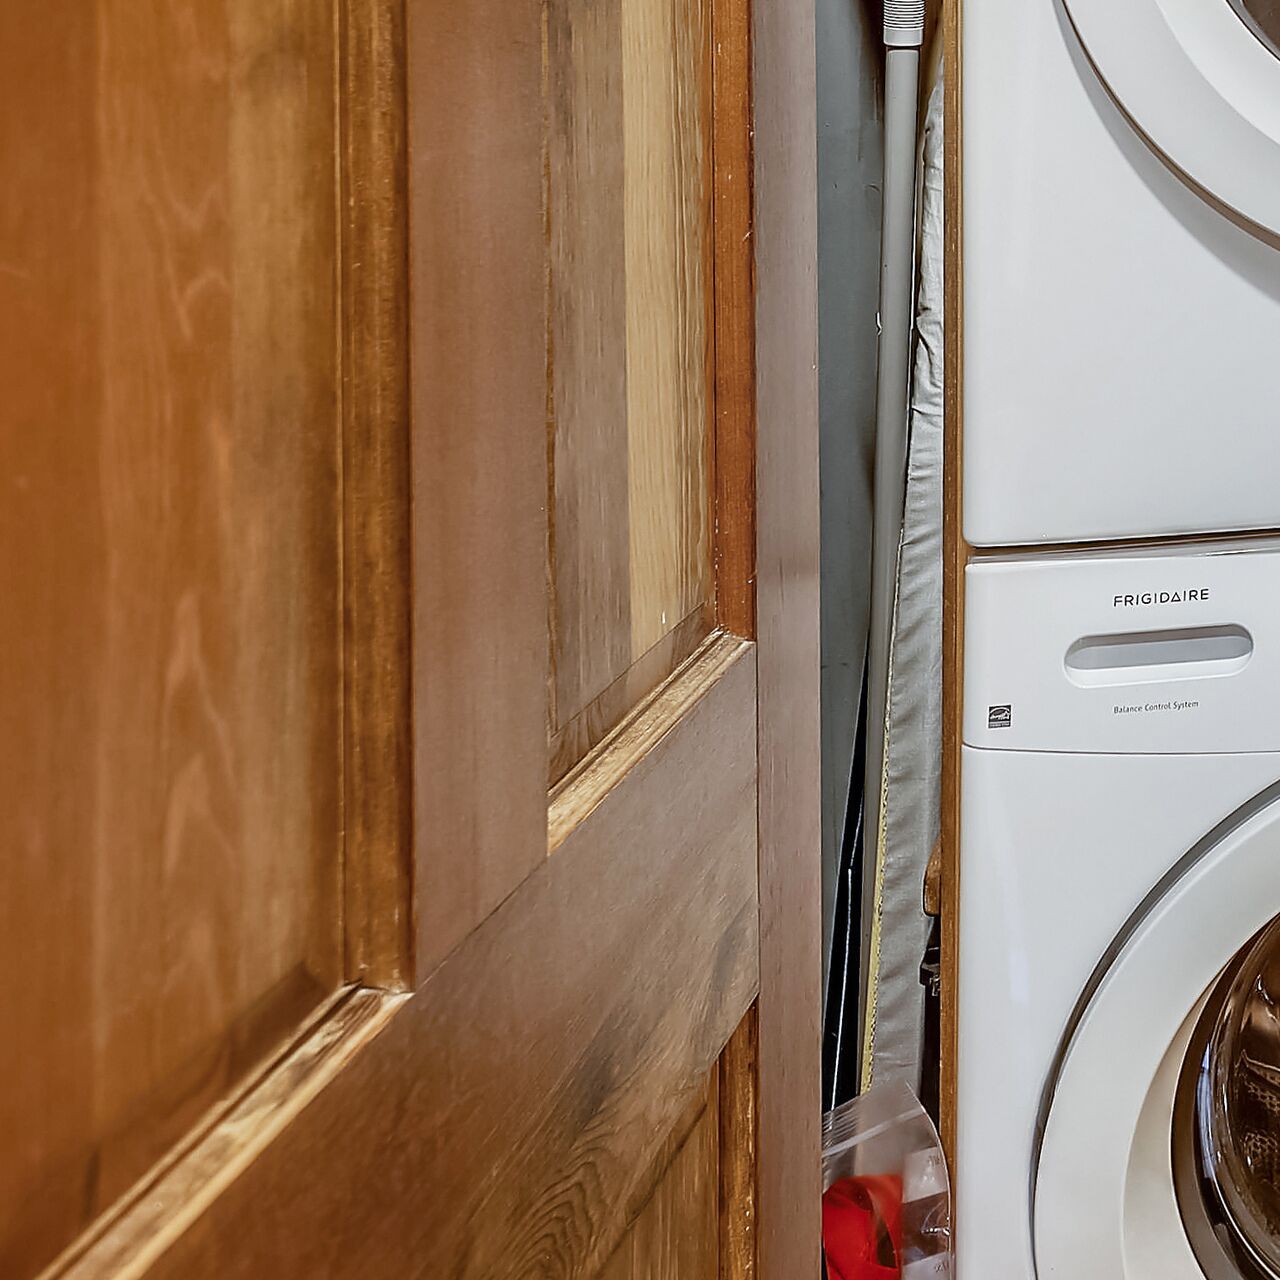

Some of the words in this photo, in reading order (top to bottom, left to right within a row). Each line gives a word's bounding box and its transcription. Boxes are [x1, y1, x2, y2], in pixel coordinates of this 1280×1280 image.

[1113, 588, 1209, 607] FRIGIDAIRE
[1113, 705, 1143, 715] Balance
[1144, 702, 1172, 713] Control
[1173, 700, 1200, 712] System
